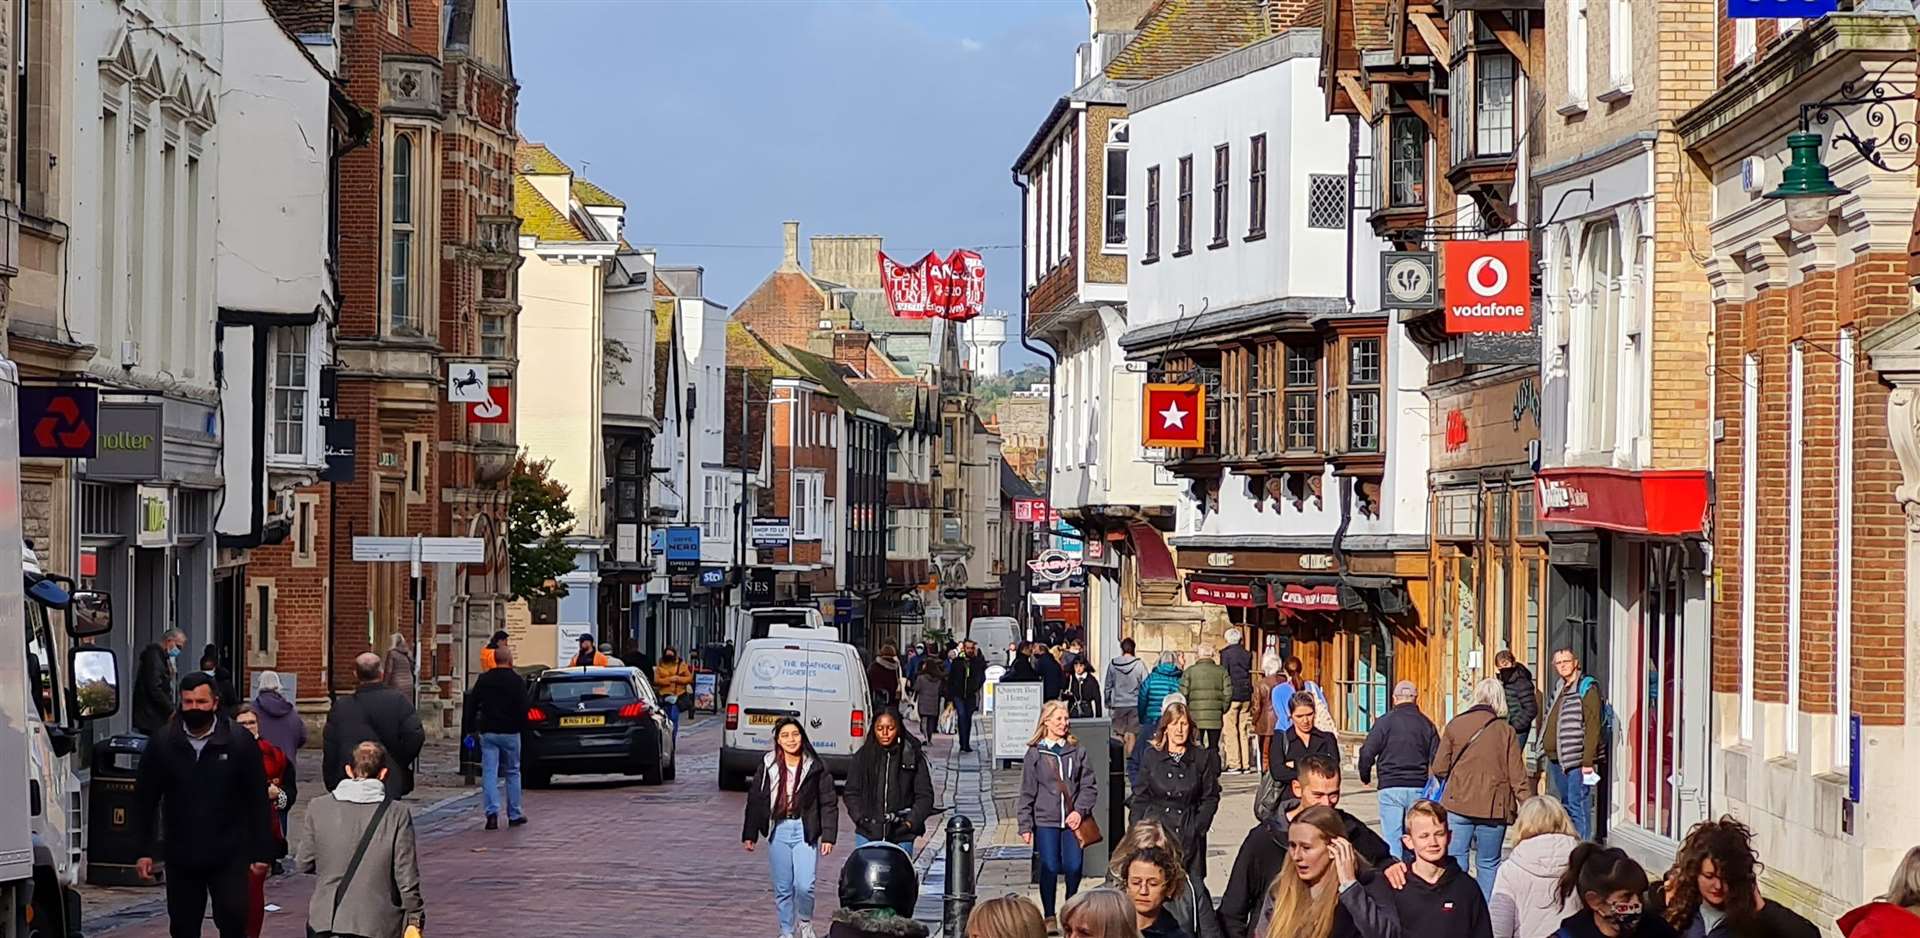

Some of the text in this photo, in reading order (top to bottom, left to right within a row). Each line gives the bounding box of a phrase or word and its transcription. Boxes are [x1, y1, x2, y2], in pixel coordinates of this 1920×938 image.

[893, 279, 920, 291] TER
[1452, 302, 1525, 317] vodafone
[669, 543, 698, 551] NERO
[800, 661, 841, 671] BOATHOUSE
[782, 669, 817, 677] FISHERIES
